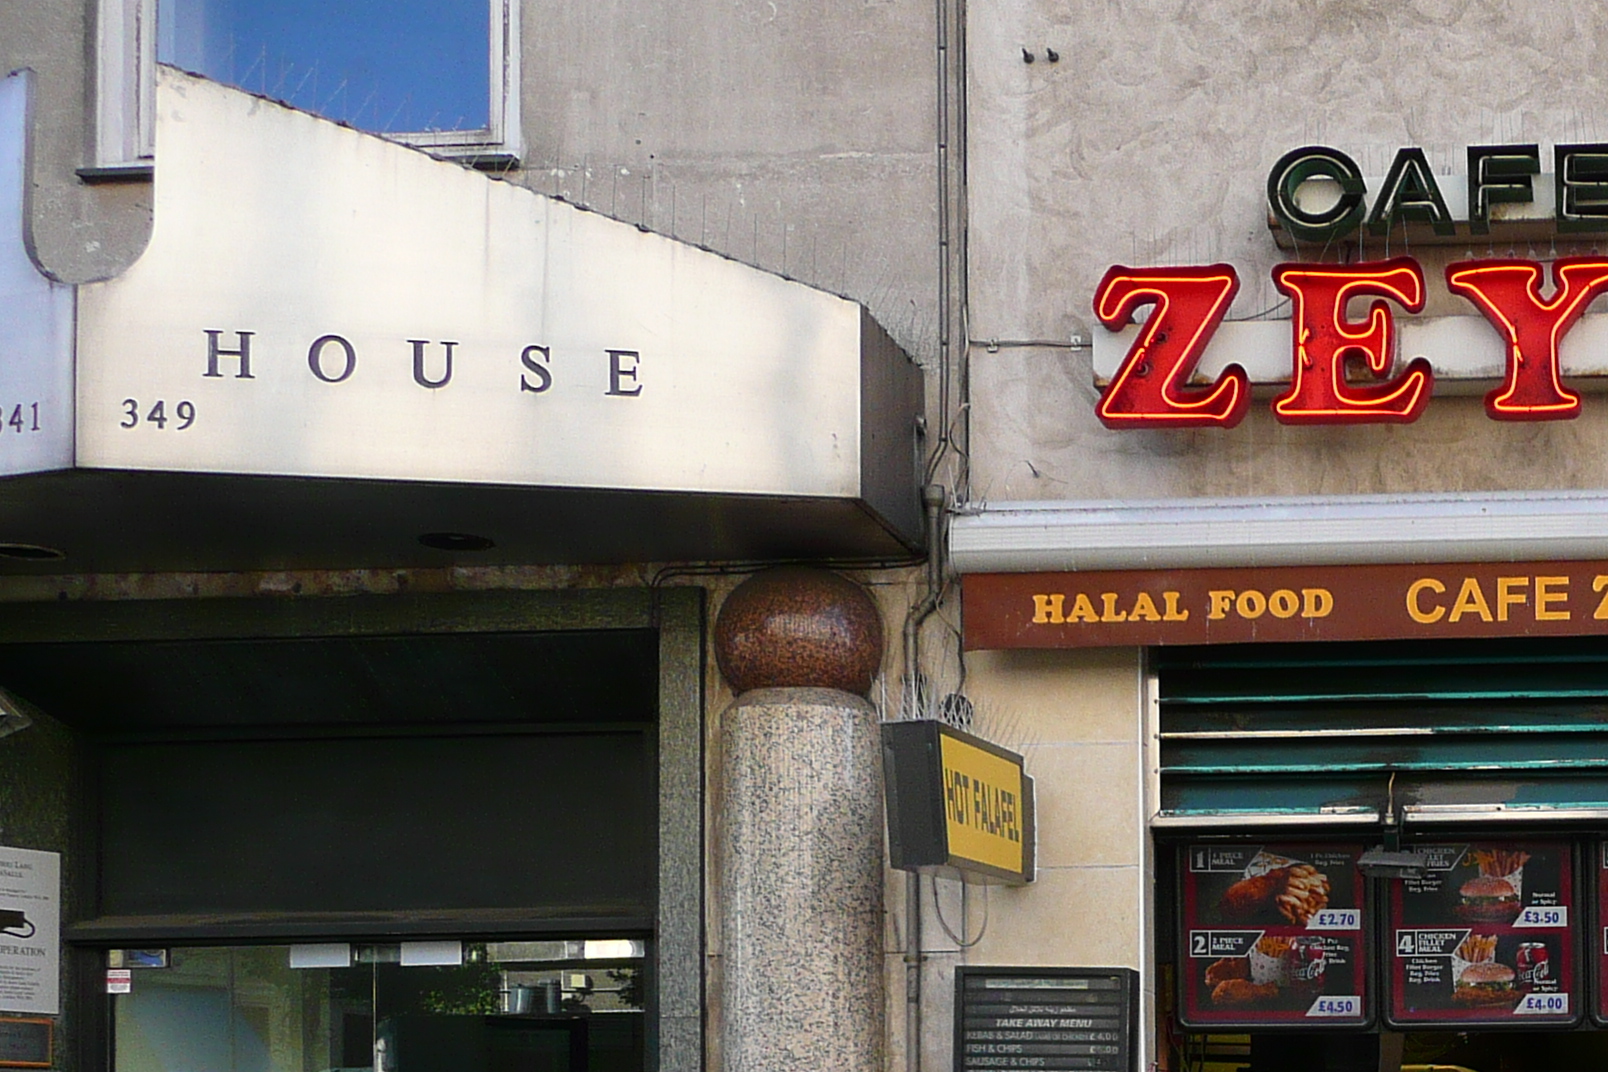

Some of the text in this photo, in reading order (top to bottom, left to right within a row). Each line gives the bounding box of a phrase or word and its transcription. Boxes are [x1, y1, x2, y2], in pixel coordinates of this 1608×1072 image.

[203, 328, 645, 398] HOUSE
[119, 399, 196, 431] 349
[1031, 588, 1333, 624] HALAL FOOD
[1405, 575, 1572, 624] CAFE
[944, 768, 1020, 843] HOT FALAFEL
[1195, 851, 1205, 869] 1
[1318, 913, 1355, 927] £2.70
[1524, 911, 1560, 924] £3.50
[1193, 935, 1208, 954] 2
[1398, 932, 1457, 953] 4 CHICKEN
[1317, 1000, 1354, 1014] £4.50
[1526, 997, 1563, 1011] £4.00
[995, 1018, 1093, 1028] TAKE AWAY MENU
